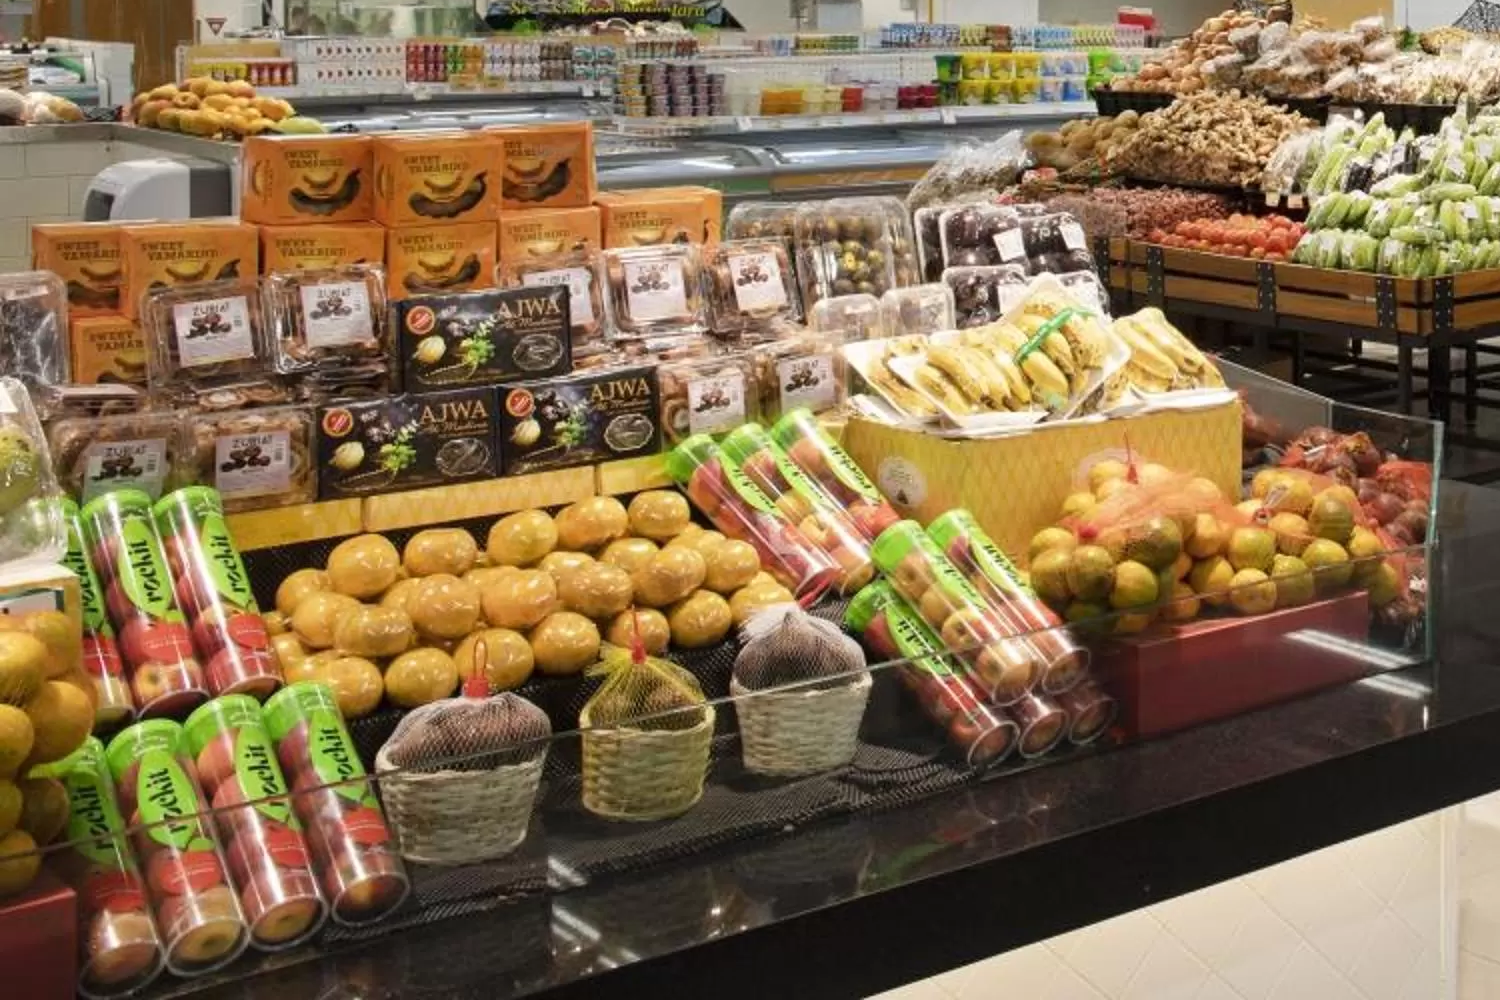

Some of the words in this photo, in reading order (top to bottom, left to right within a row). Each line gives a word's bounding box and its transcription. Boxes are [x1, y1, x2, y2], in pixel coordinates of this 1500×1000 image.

[499, 298, 560, 319] AJWA
[96, 339, 144, 352] TAMAR
[420, 400, 489, 424] AJWA
[591, 377, 650, 401] AJWA
[128, 540, 163, 602] rockit
[211, 535, 247, 593] rockit
[319, 727, 355, 784] ockit
[73, 786, 114, 851] rockit
[146, 767, 189, 834] rockit
